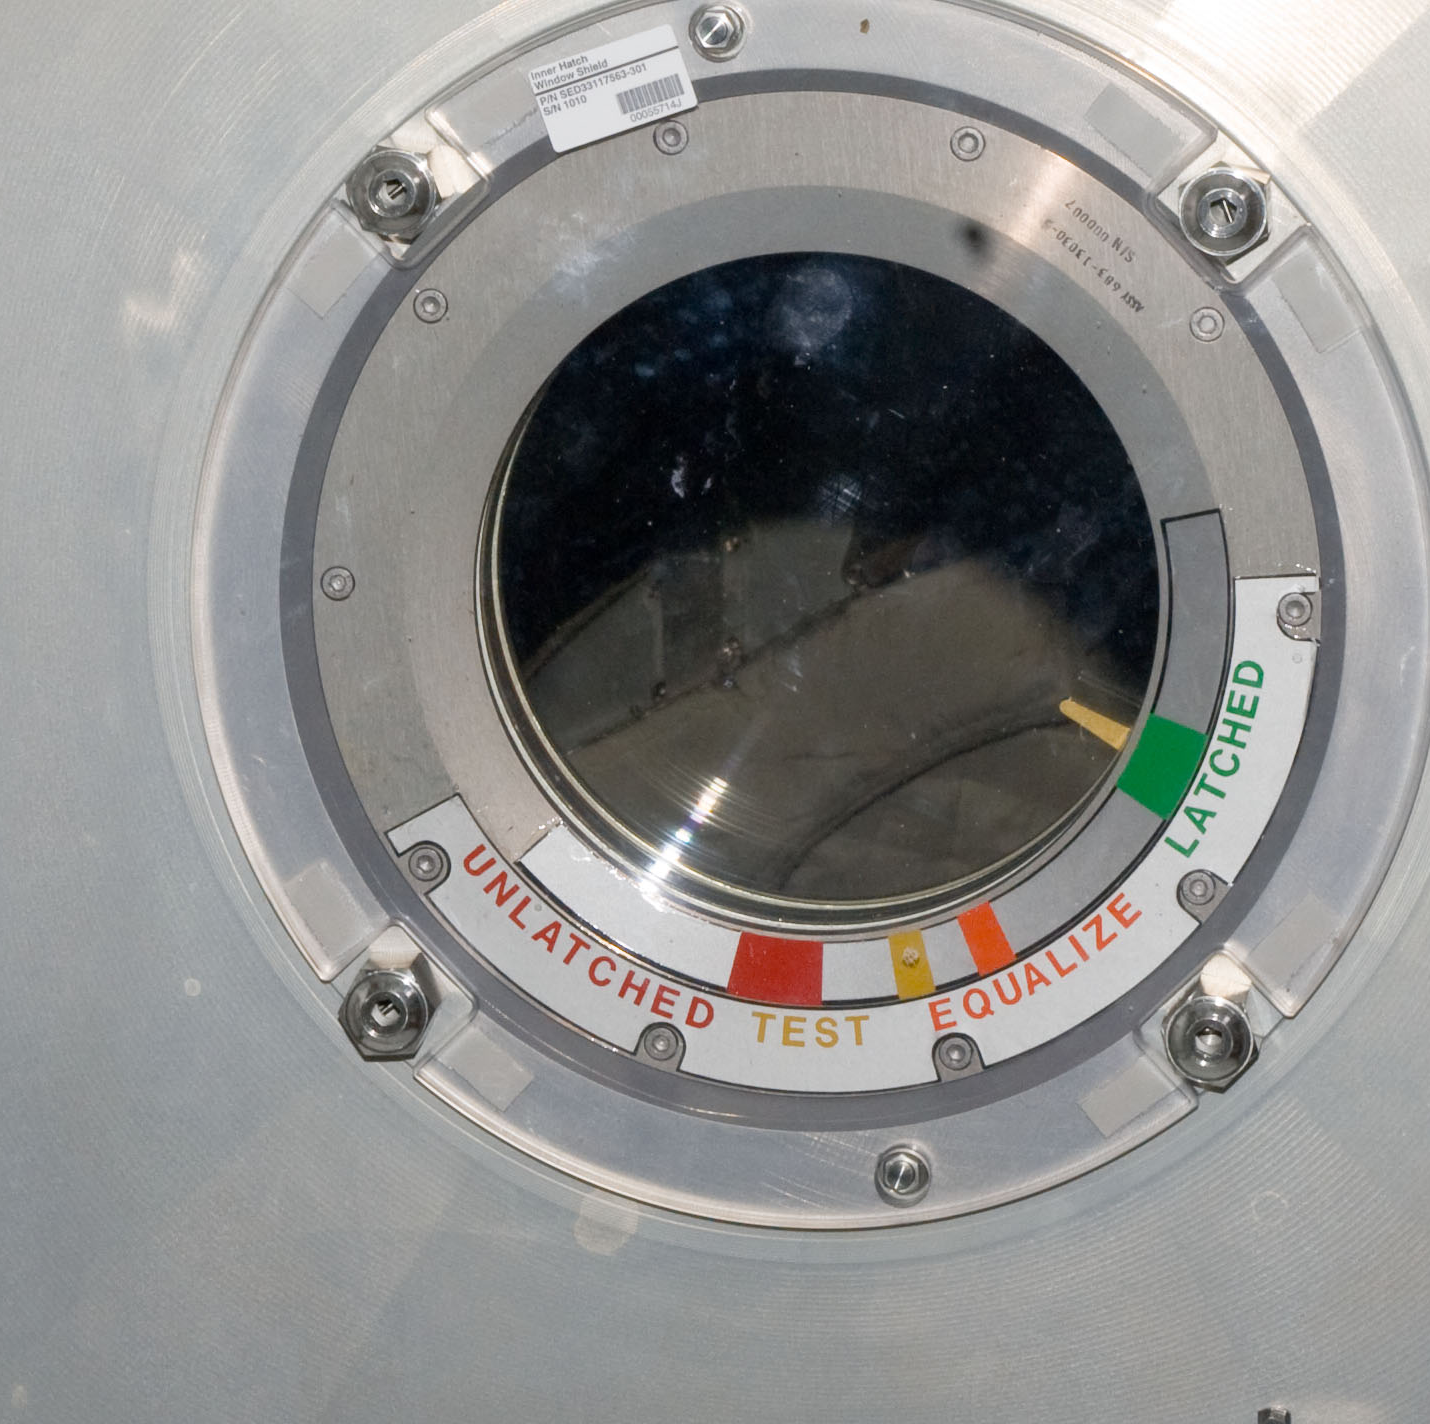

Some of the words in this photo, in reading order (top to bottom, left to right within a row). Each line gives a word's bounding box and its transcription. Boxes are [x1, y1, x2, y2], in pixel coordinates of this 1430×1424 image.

[531, 66, 557, 80] Inner
[559, 55, 588, 71] Hatch
[534, 72, 575, 90] Window
[576, 59, 608, 77] Shield
[540, 94, 558, 106] P/N
[543, 104, 561, 116] S/N
[564, 95, 587, 108] 1010
[1112, 237, 1135, 263] S/N
[1120, 291, 1145, 312] ASSY
[1163, 658, 1266, 859] LATCHED
[462, 843, 717, 1031] UNLATCHED
[928, 892, 1142, 1034] EQUALIZE
[751, 1012, 869, 1049] TEST
